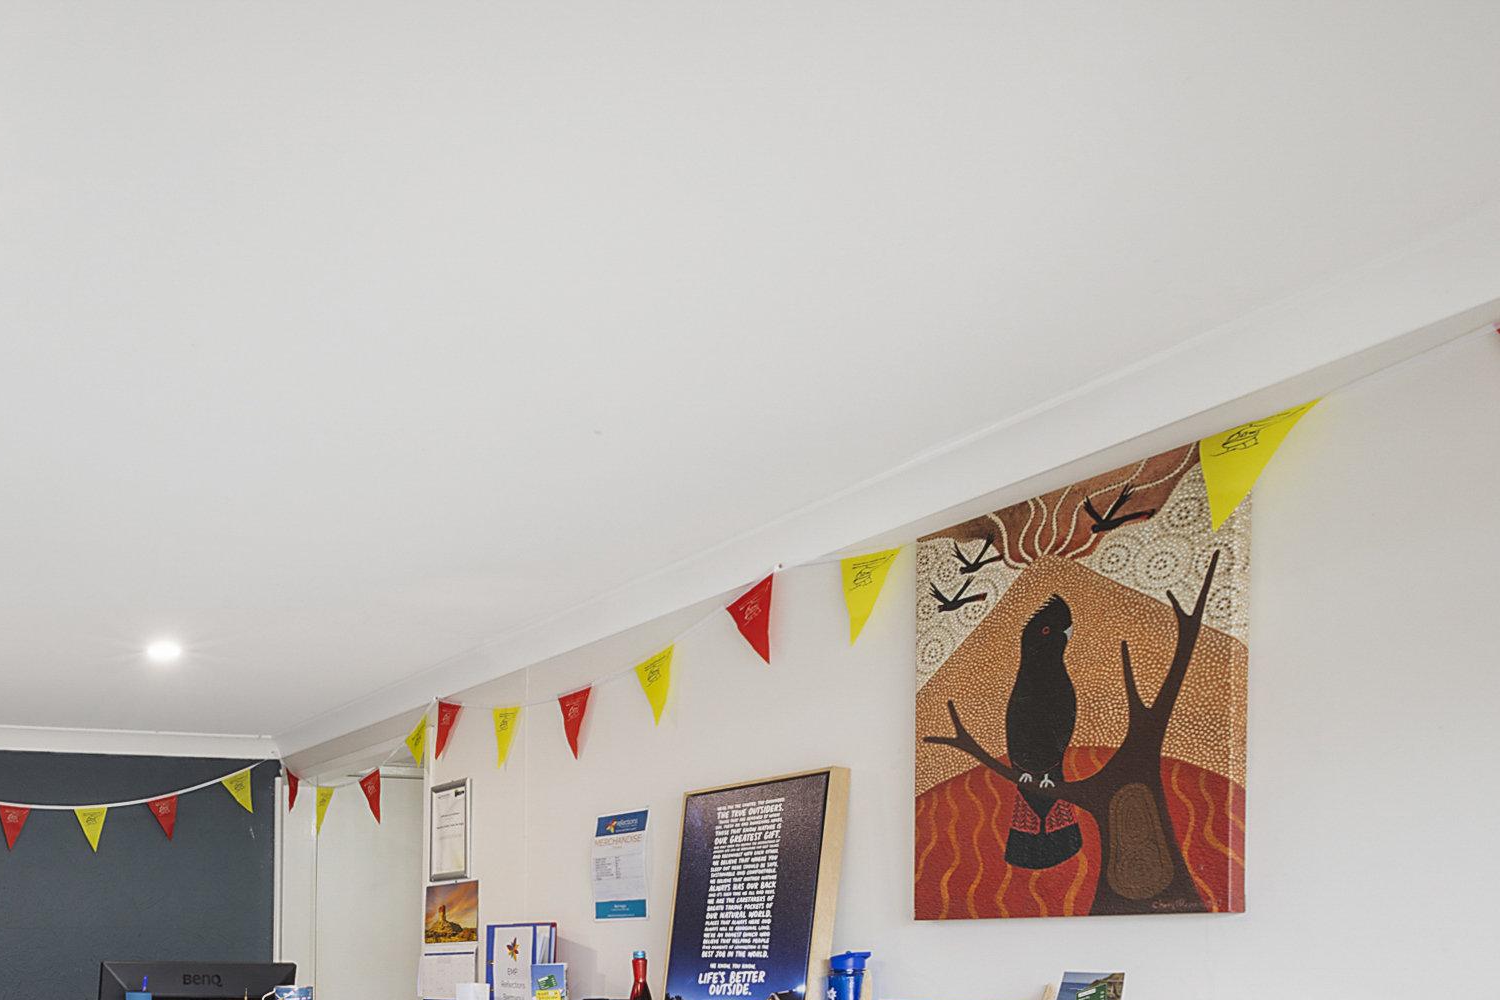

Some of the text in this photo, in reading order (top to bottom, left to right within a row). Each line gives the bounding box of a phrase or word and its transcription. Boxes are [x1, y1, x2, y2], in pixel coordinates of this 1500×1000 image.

[717, 811, 729, 819] THE
[732, 809, 746, 817] TRUE
[748, 803, 784, 815] OUTSIDERS.
[714, 830, 781, 845] OUR GREATEST GIFT.
[748, 910, 772, 918] WORLD.
[698, 971, 766, 984] LIFE'S BETTER
[709, 983, 752, 996] OUTSIDE.
